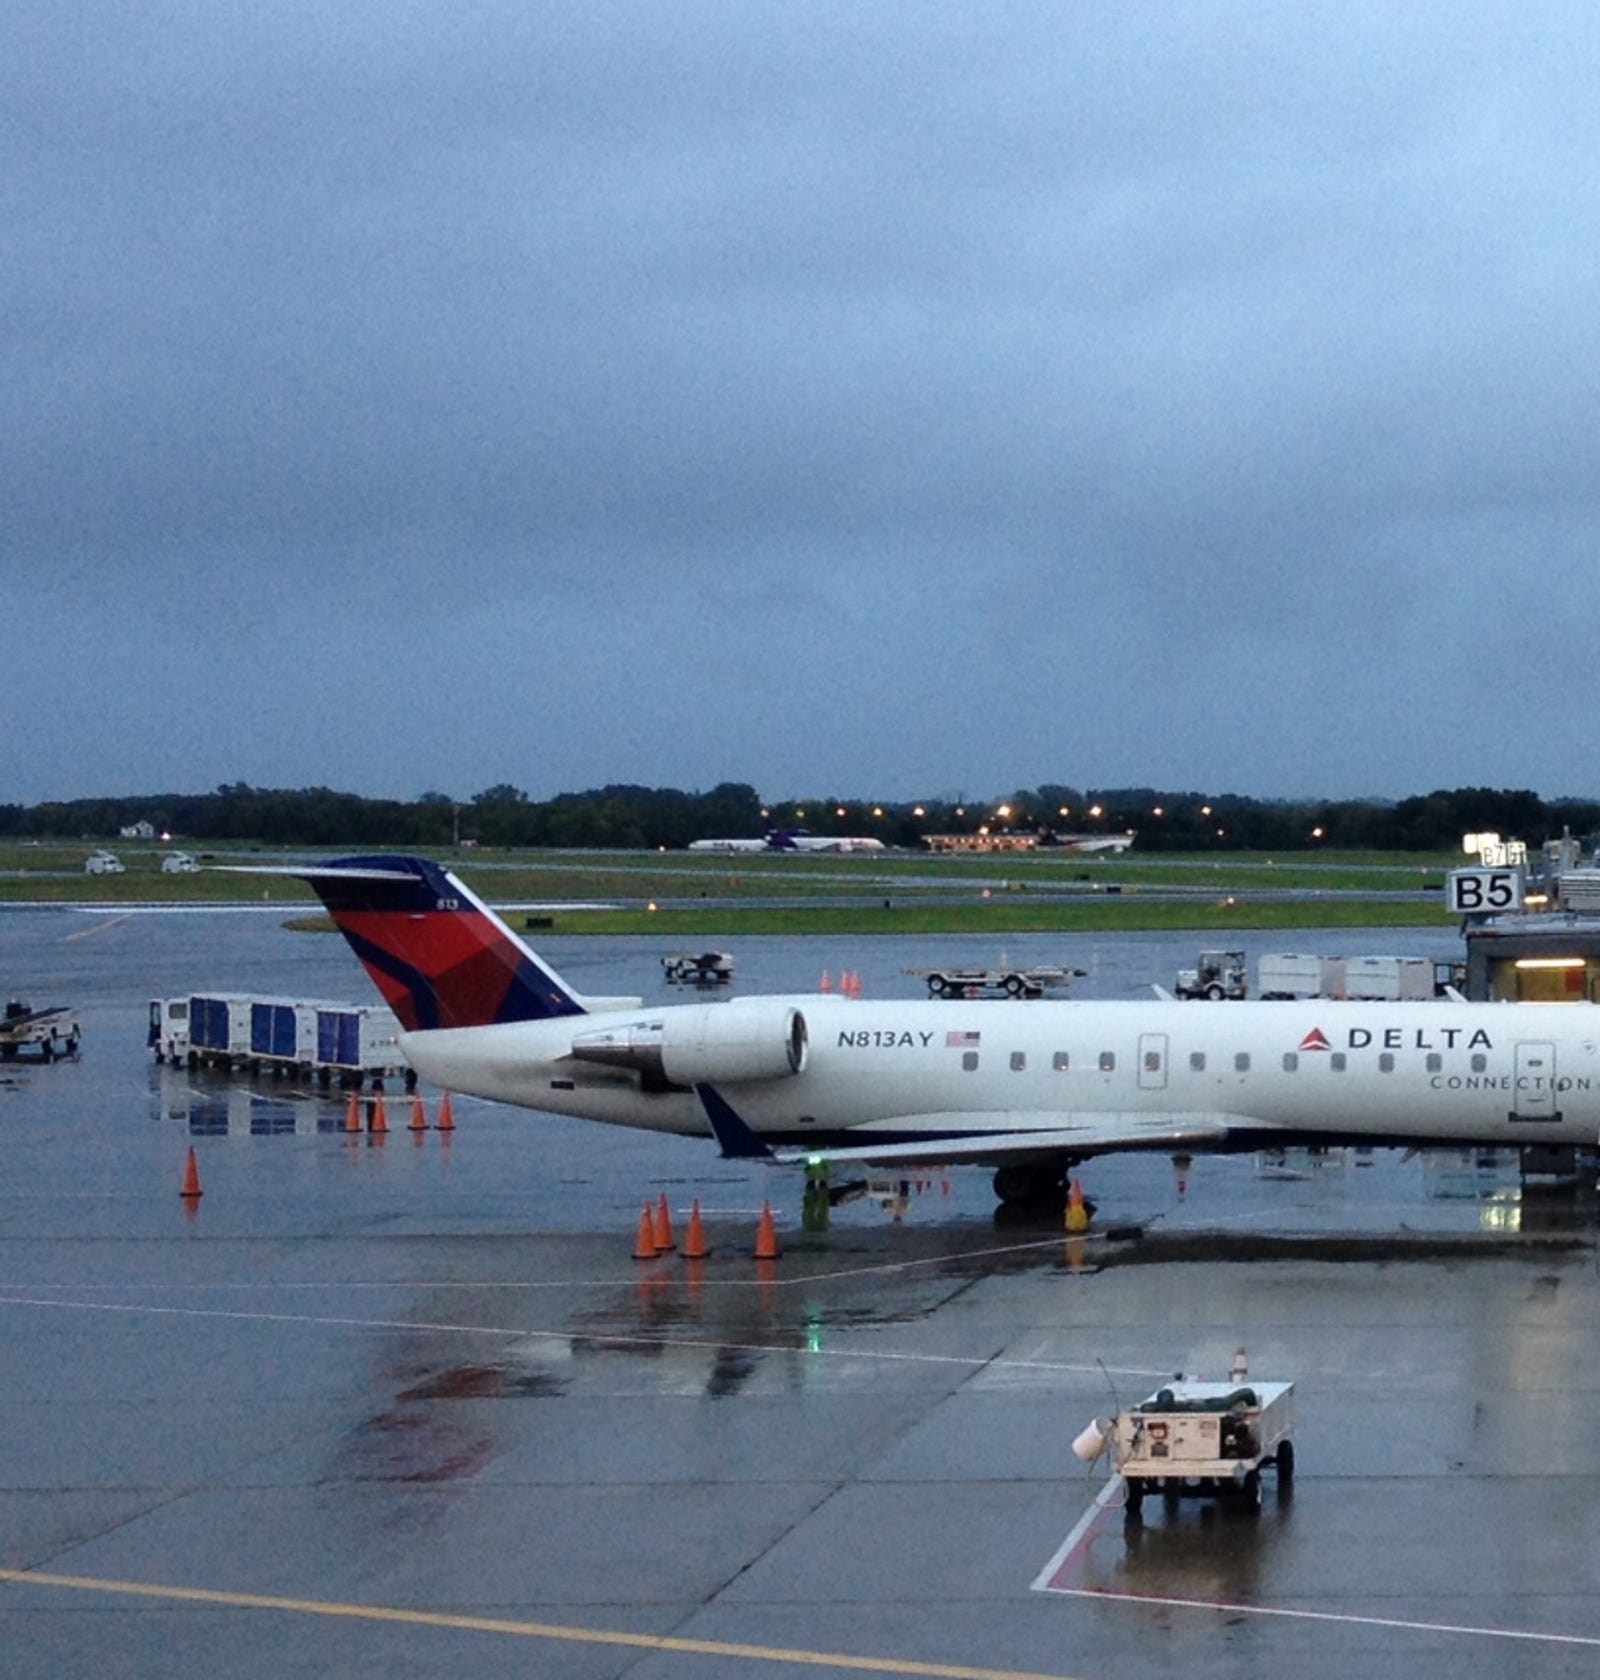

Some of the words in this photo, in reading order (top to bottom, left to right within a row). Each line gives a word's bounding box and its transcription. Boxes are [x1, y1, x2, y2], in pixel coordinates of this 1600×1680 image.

[1456, 874, 1513, 910] B5
[837, 1031, 934, 1048] N813AY
[1348, 1028, 1493, 1049] DELTA
[1430, 1076, 1591, 1090] CONNECTION
